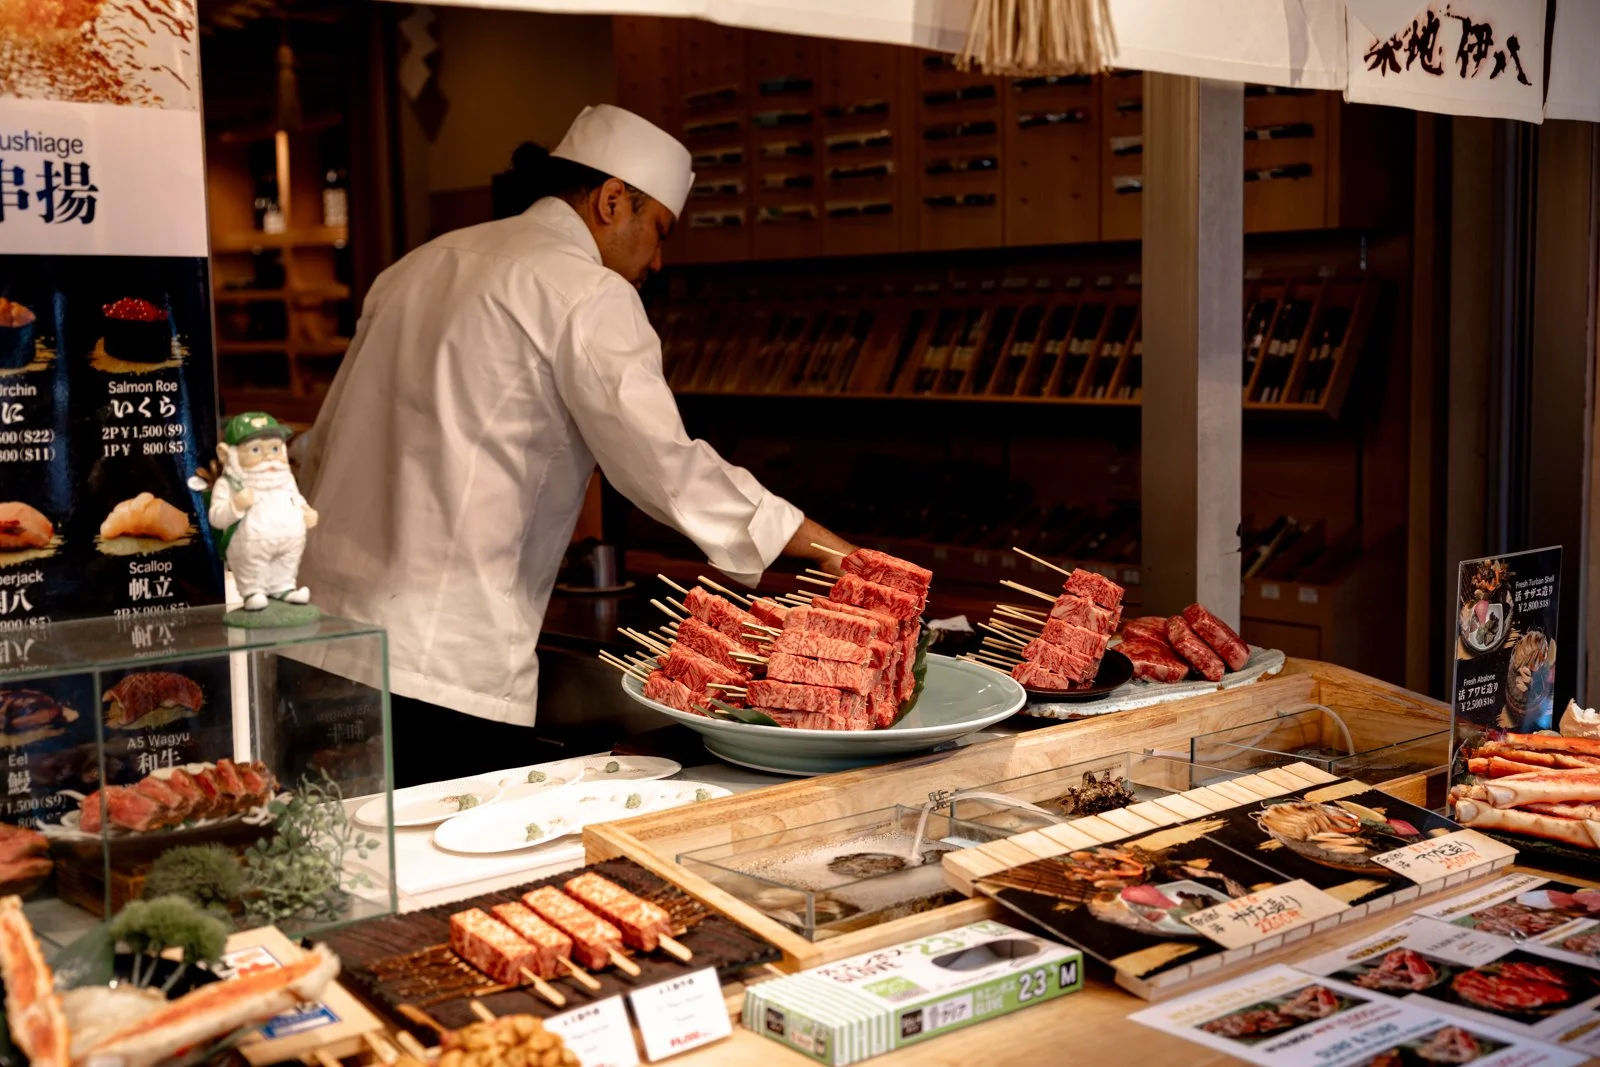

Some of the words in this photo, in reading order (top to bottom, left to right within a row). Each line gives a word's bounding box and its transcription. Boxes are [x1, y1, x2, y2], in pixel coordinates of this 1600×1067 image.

[108, 381, 153, 394] Salmon
[155, 380, 178, 392] Roe
[2, 402, 25, 425] に
[111, 395, 176, 418] いくら
[129, 560, 173, 574] Scallop
[129, 576, 174, 601] 帆立
[1515, 580, 1528, 589] Fresh
[1529, 578, 1544, 586] Turban
[0, 589, 34, 616] 八
[1463, 677, 1477, 687] Fresh
[1477, 674, 1496, 684] Abalone
[148, 732, 190, 748] Wagyu
[8, 752, 29, 768] Eel
[137, 748, 181, 775] 和牛
[1018, 968, 1048, 1002] 23
[1060, 962, 1077, 987] M
